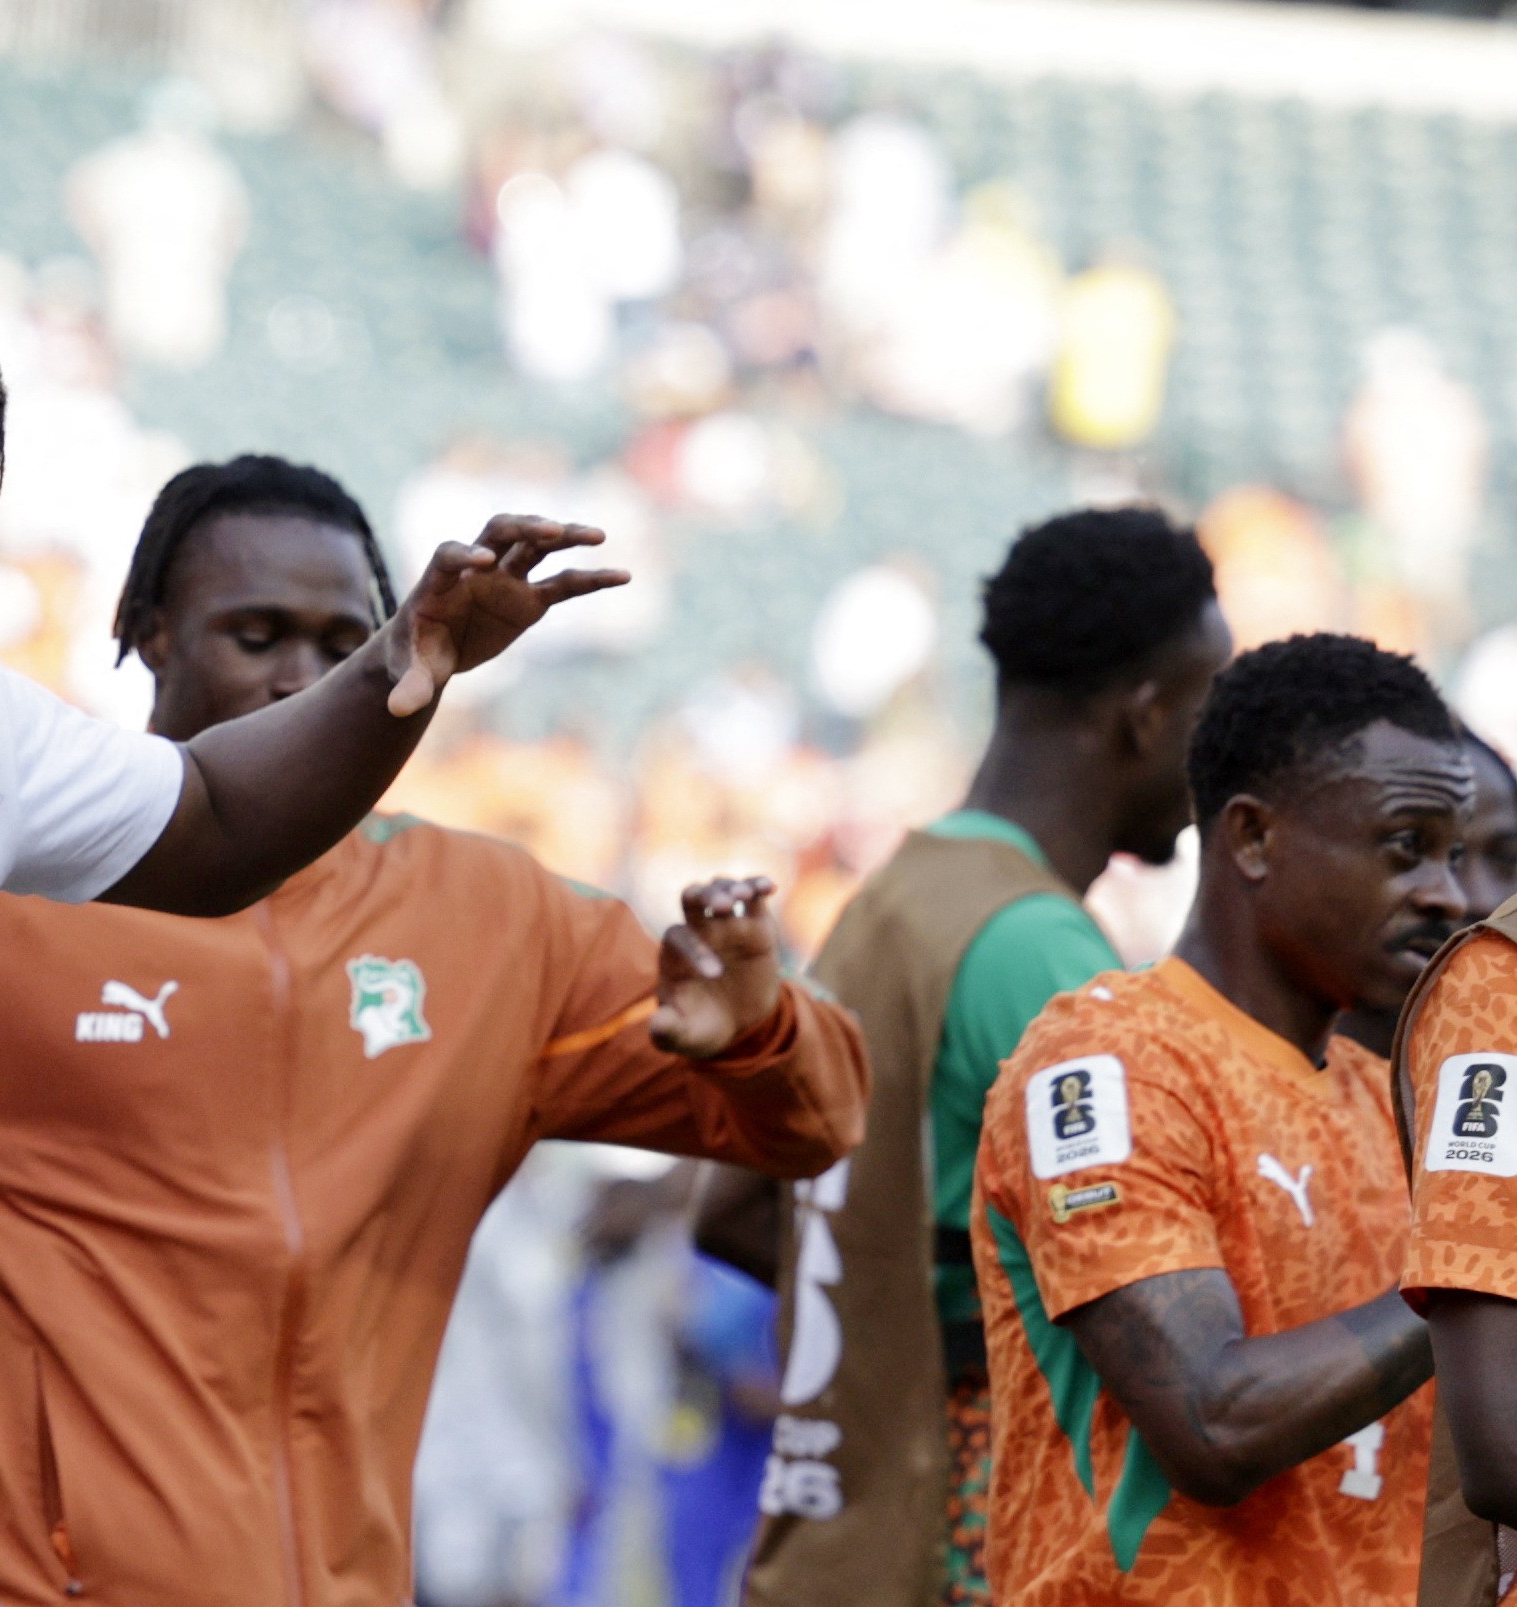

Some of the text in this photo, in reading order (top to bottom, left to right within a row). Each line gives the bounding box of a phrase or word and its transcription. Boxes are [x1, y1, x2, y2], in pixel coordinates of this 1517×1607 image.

[75, 1010, 145, 1043] KING
[1461, 1121, 1486, 1132] FIFA
[1445, 1149, 1495, 1163] 2026
